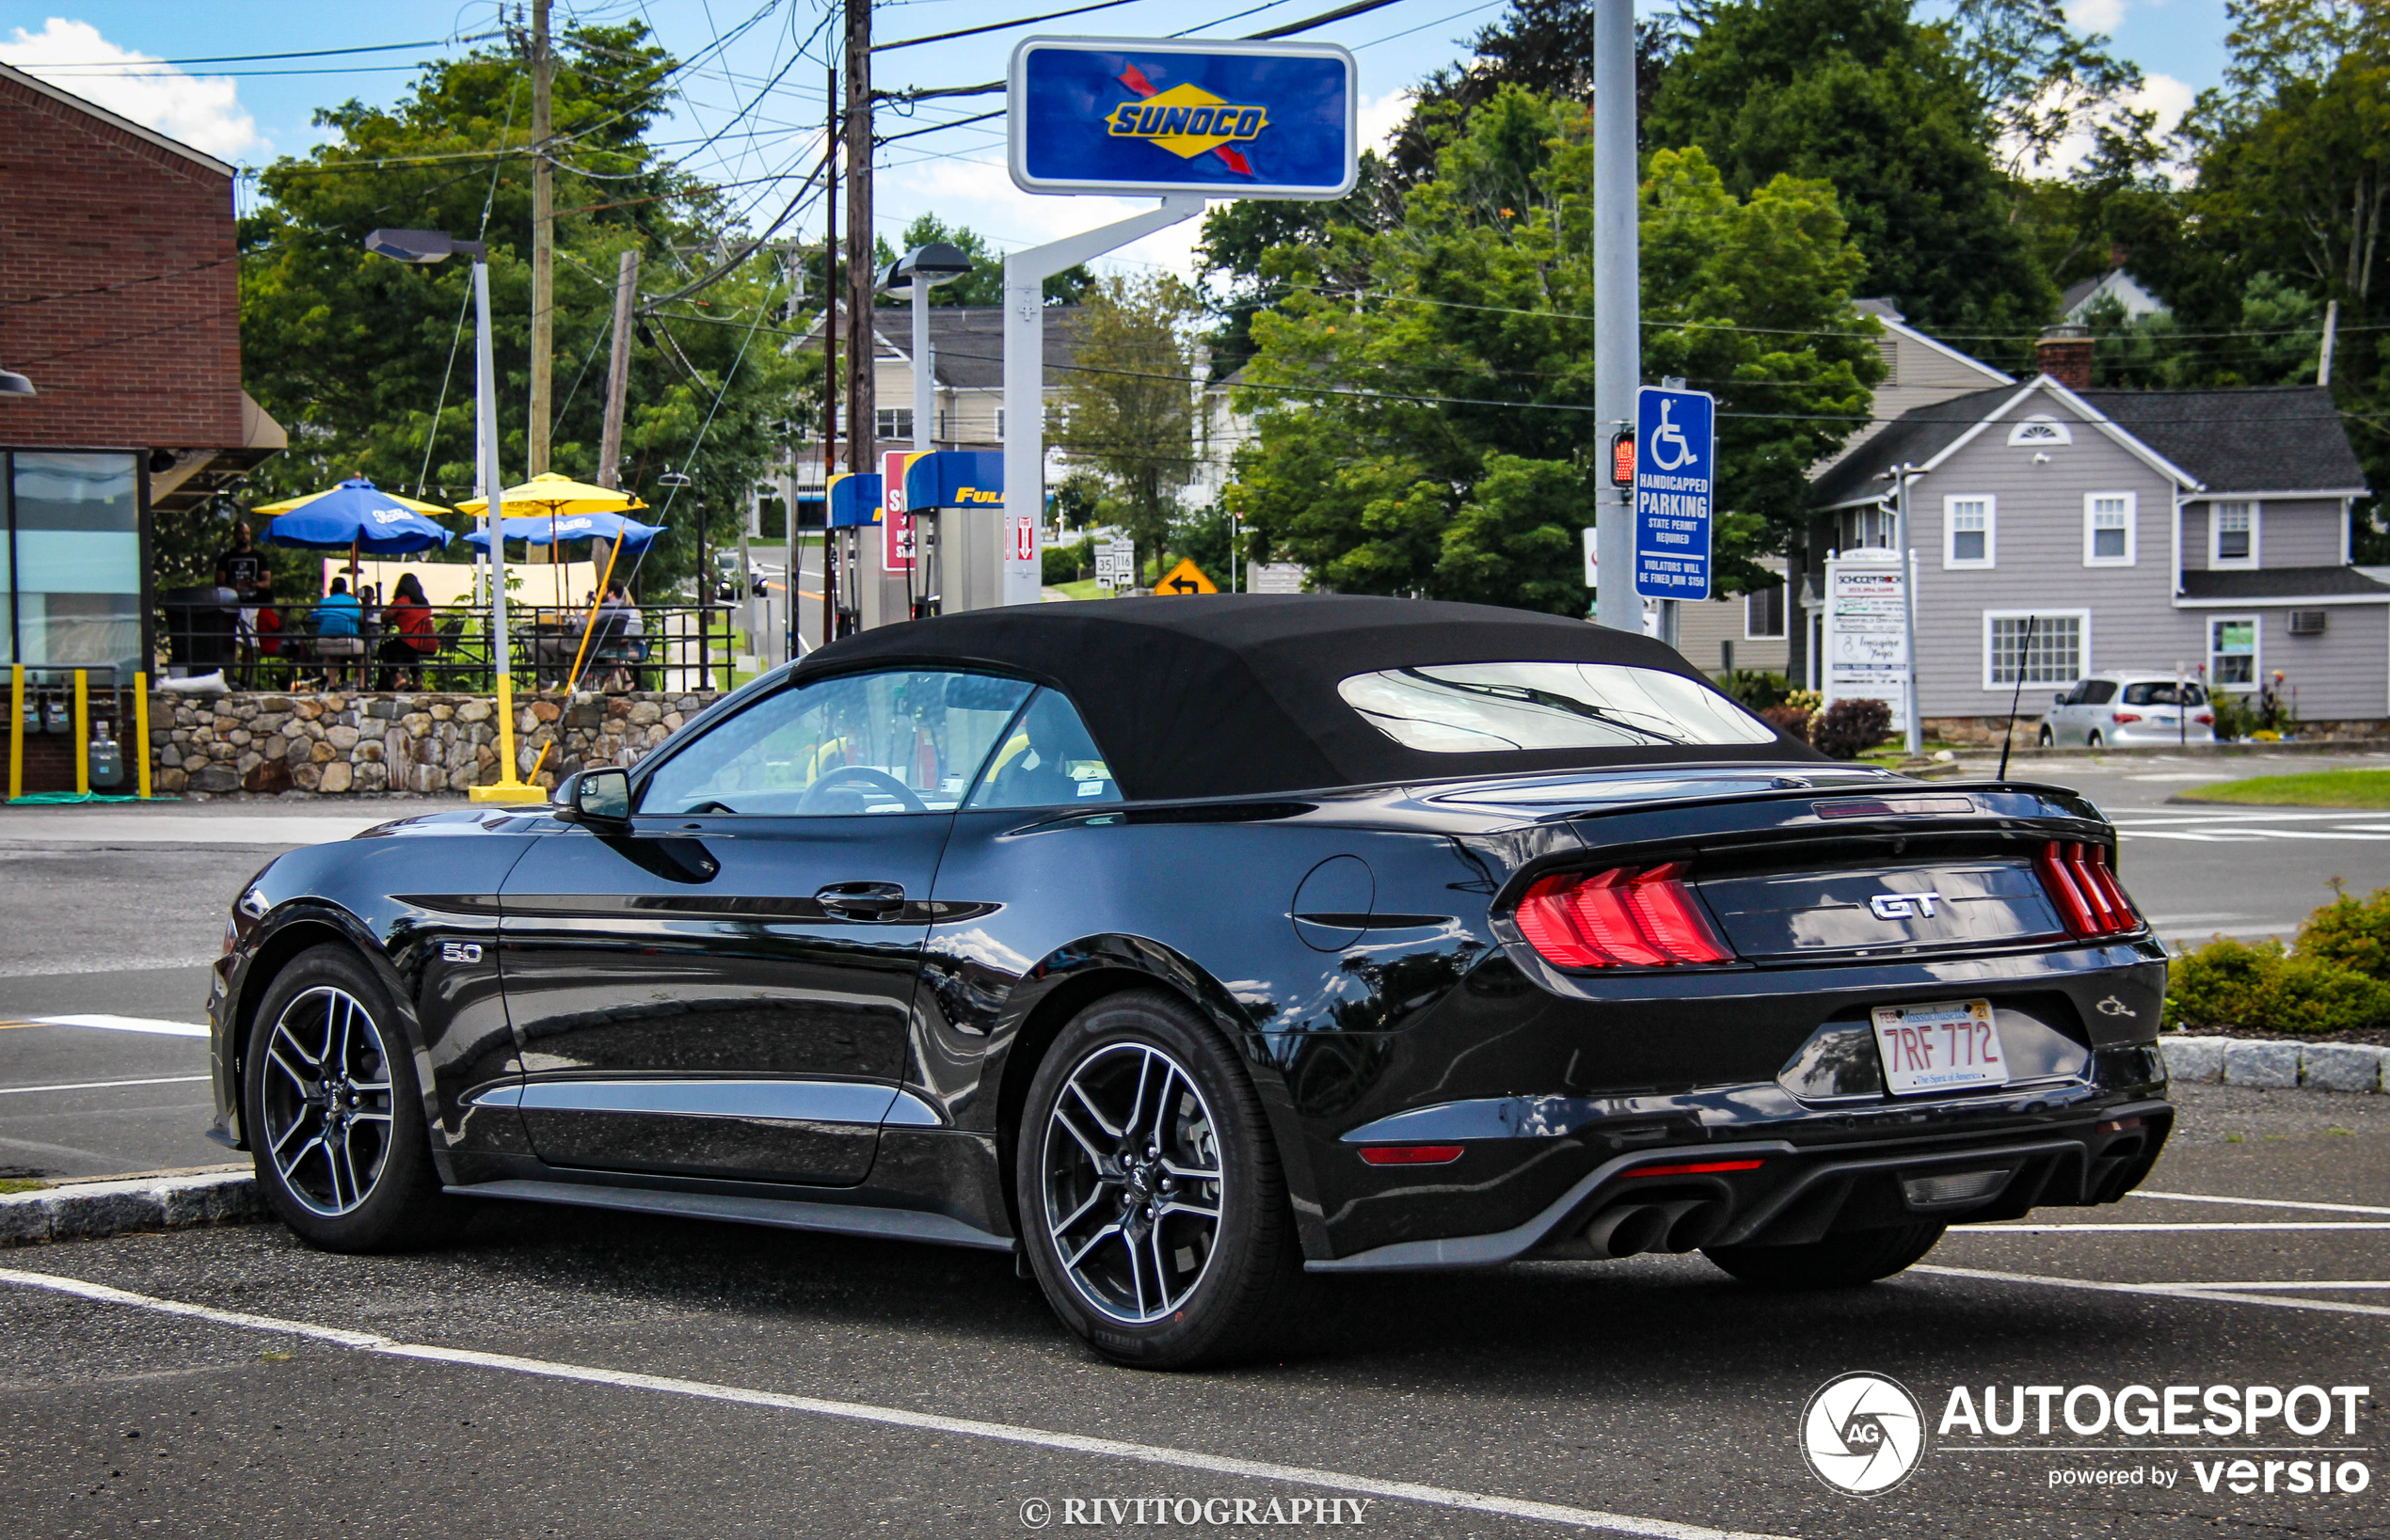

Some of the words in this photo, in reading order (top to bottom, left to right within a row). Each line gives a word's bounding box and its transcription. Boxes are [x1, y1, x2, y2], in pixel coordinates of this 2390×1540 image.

[1112, 104, 1263, 137] SUNOCO
[1639, 473, 1708, 493] HANDICAPPED
[1639, 491, 1707, 518] PARKING
[1649, 517, 1669, 529] STATE
[1672, 519, 1697, 532] PERMIT
[1656, 532, 1689, 545] REQUIRED
[1098, 560, 1111, 571] 35
[1117, 555, 1130, 566] 116
[1644, 560, 1681, 572] VIOLATORS
[1683, 563, 1700, 574] WILL
[1639, 572, 1649, 582] BE
[1650, 573, 1670, 584] FINED
[1672, 575, 1685, 585] MIN
[1688, 576, 1704, 587] $150
[1860, 636, 1899, 649] Imagine
[1871, 649, 1893, 659] Yoga
[1870, 892, 1939, 919] GT
[443, 943, 483, 962] 5.0
[1878, 1012, 1896, 1024] FEB
[1902, 1006, 1967, 1024] Massachusetts
[1977, 1007, 1987, 1018] 21
[1884, 1025, 1934, 1072] 7RF
[1941, 1021, 1998, 1067] 772
[1916, 1075, 1929, 1085] The
[1930, 1074, 1946, 1084] Spirit
[1948, 1073, 1954, 1082] of
[1955, 1072, 1982, 1081] America
